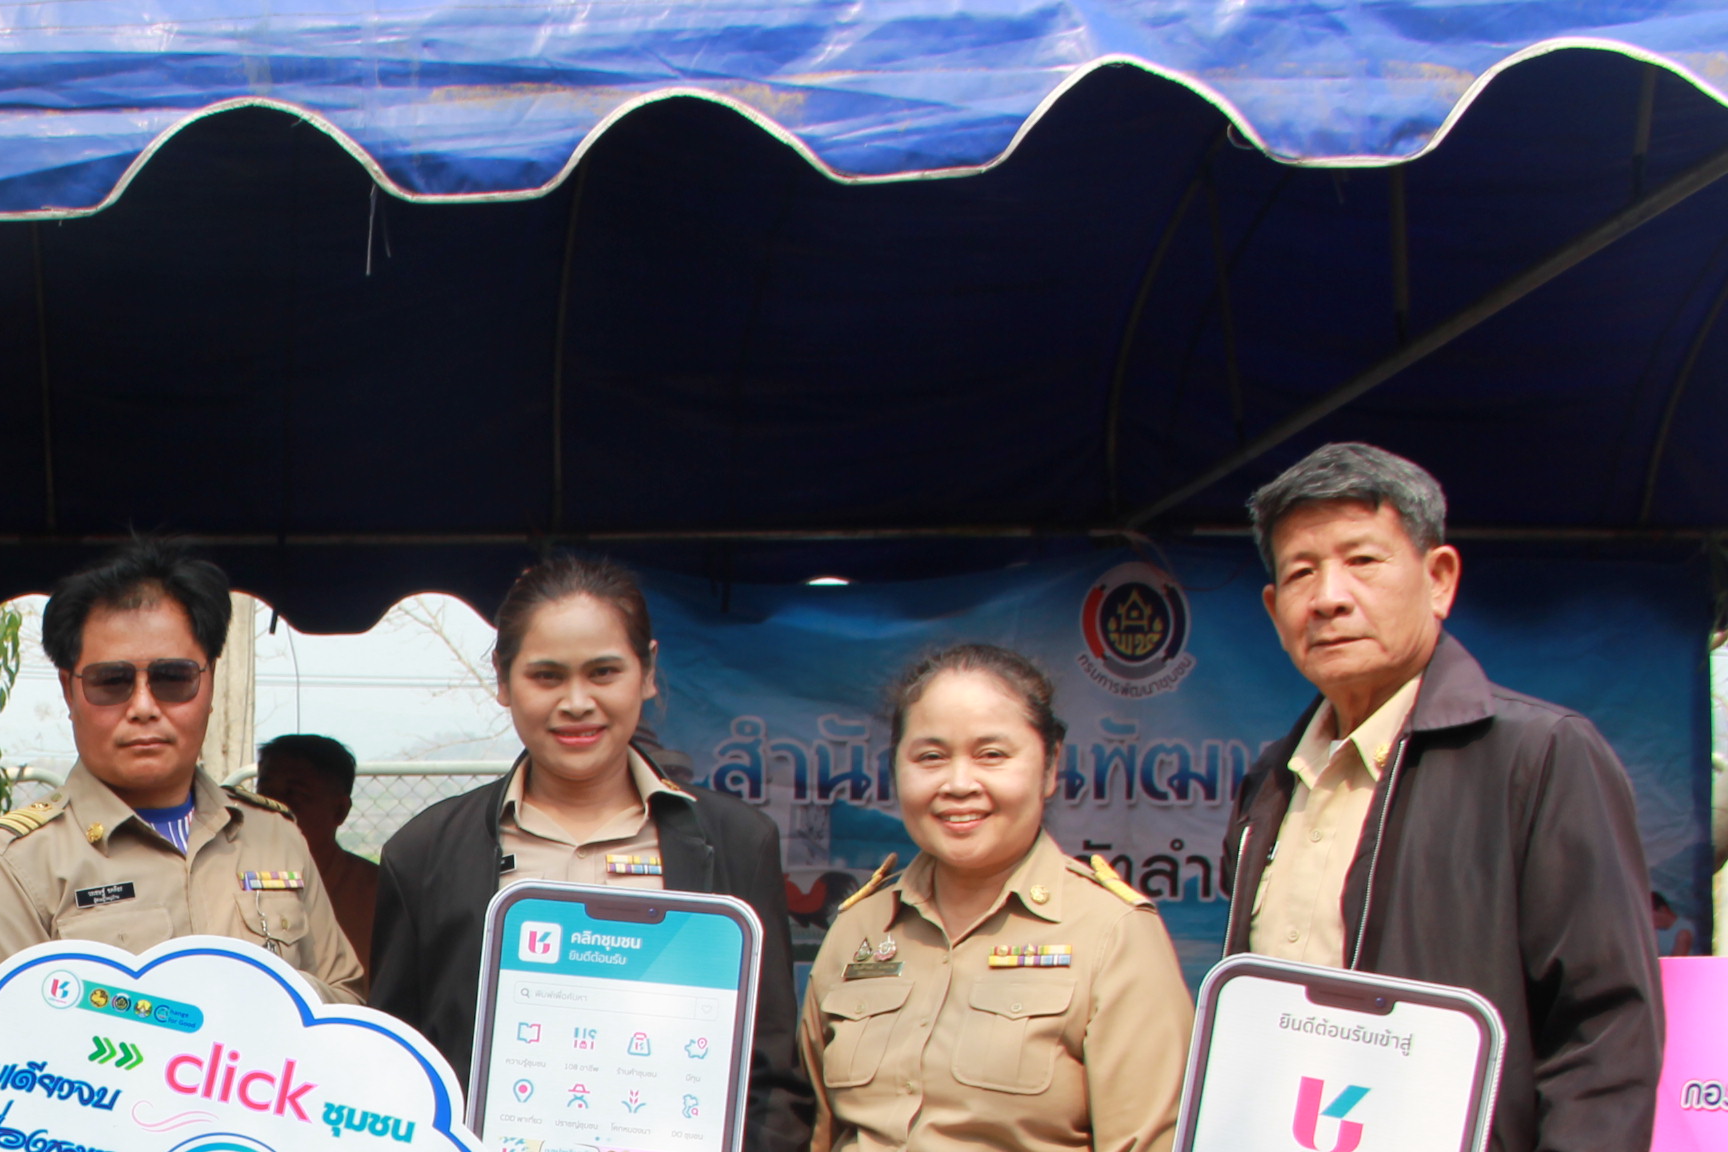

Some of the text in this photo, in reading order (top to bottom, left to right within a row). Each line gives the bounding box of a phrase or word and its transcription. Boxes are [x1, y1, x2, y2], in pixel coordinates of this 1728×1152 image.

[568, 950, 627, 965] ยินดีต้อนรับ
[570, 931, 641, 951] คลิกชุมชน
[1279, 1013, 1413, 1056] ยินดีต้อนรับเข้าสู่
[164, 1041, 320, 1124] click
[1680, 1079, 1728, 1111] กอ
[322, 1102, 416, 1144] ชุมชน
